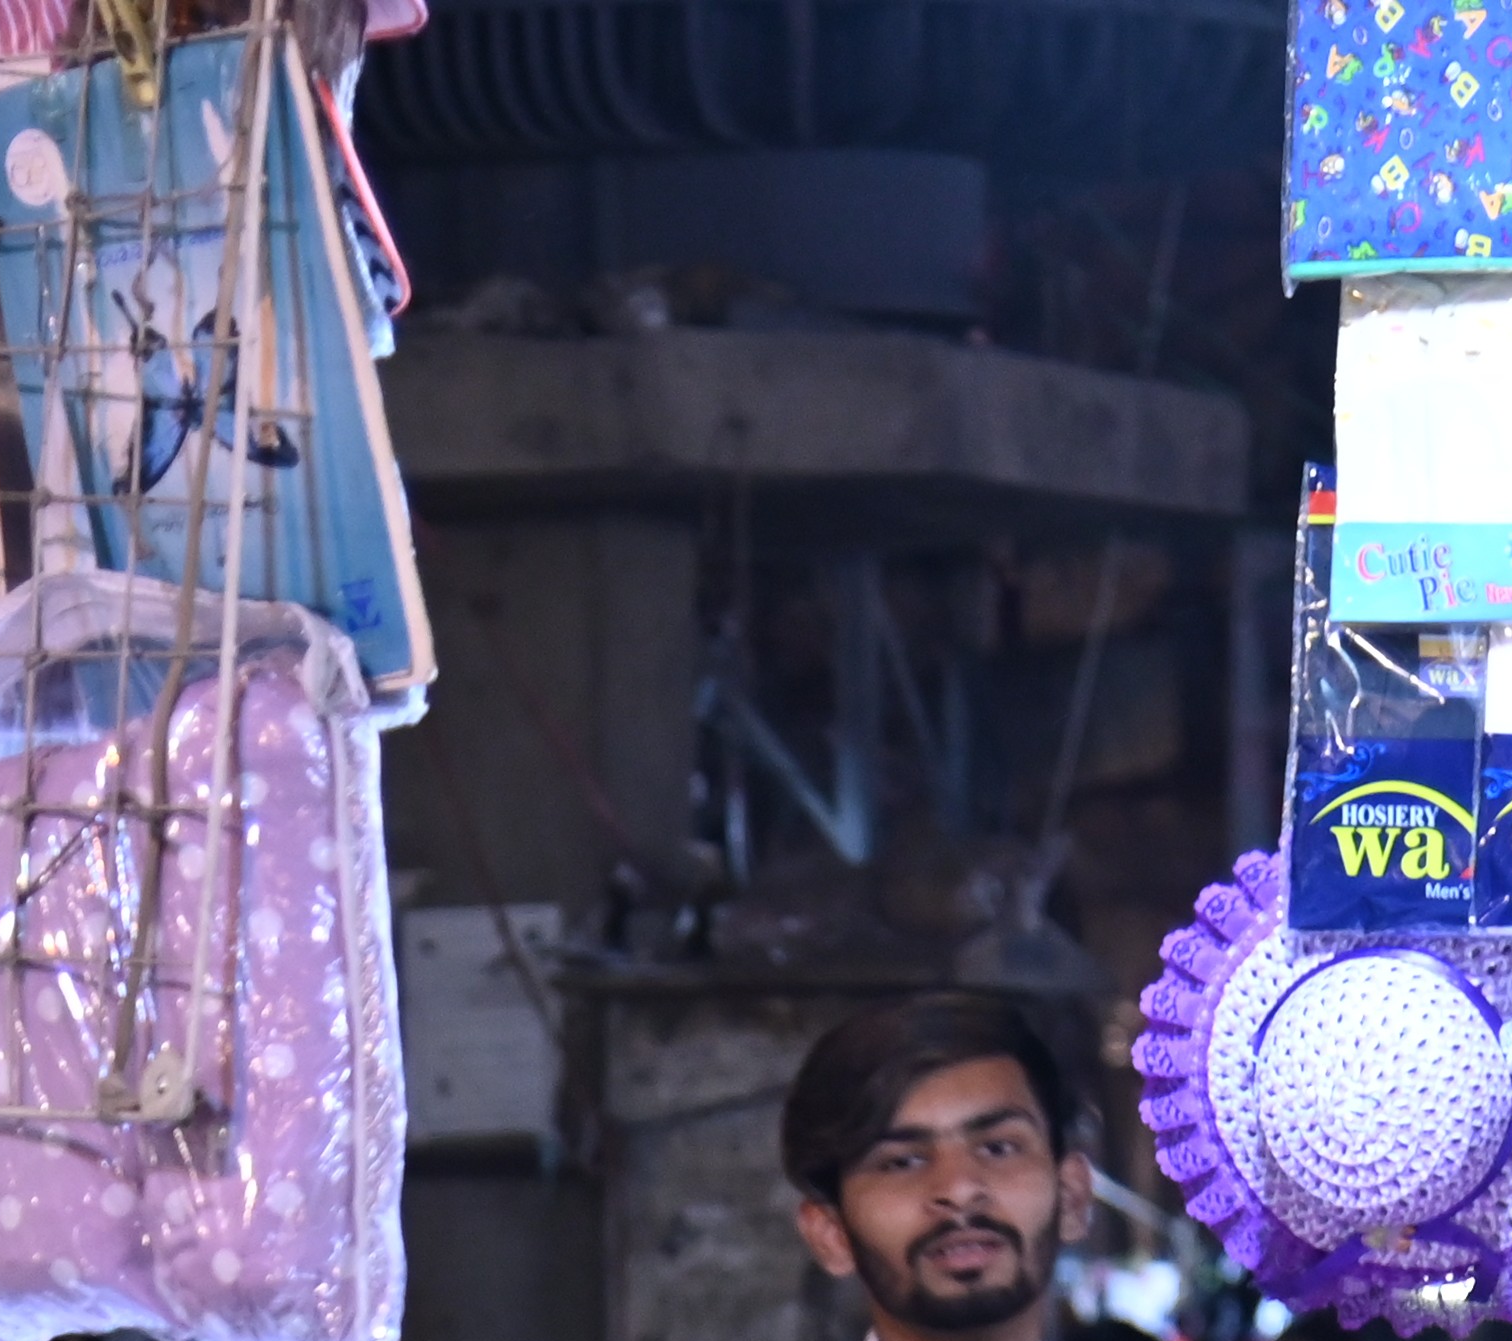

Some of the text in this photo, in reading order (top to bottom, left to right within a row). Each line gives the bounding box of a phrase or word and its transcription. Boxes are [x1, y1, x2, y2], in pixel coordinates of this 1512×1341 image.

[1355, 537, 1453, 582] Cutie
[1418, 573, 1477, 613] Pie
[1340, 803, 1440, 828] HOSIERY
[1425, 881, 1472, 901] Men's
